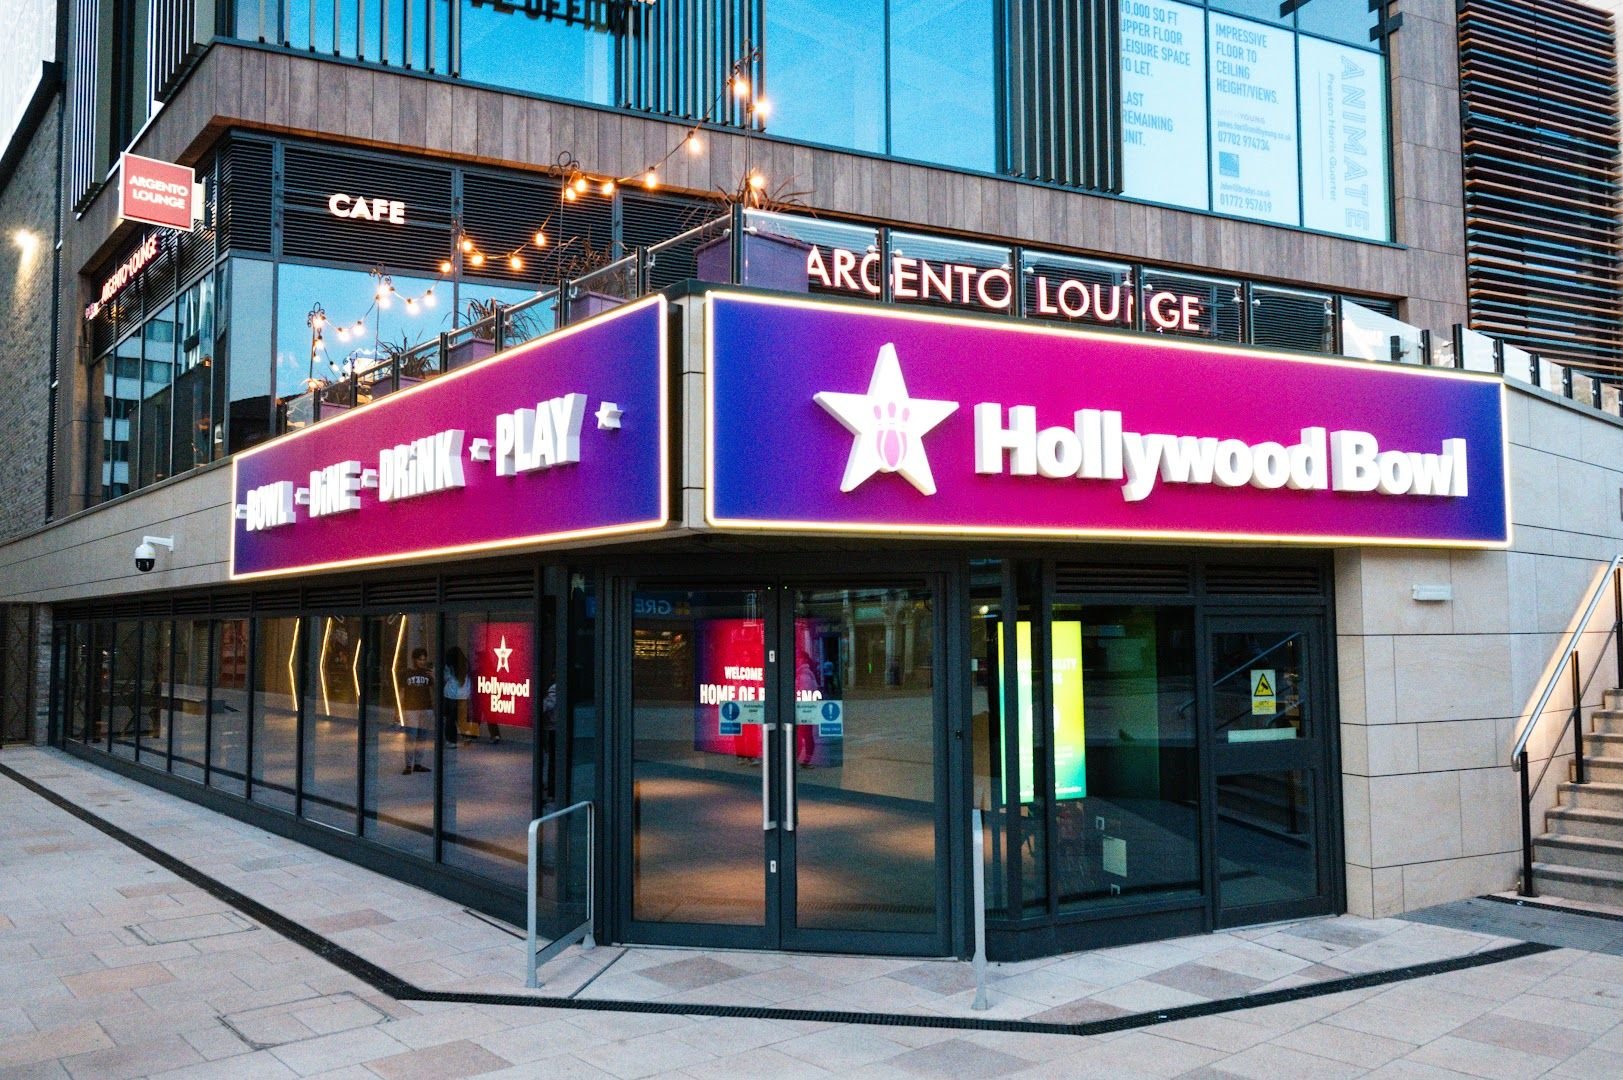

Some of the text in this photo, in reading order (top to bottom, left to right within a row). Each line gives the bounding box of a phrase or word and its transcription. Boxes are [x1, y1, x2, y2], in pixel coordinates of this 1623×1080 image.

[1153, 7, 1165, 22] SQ
[1167, 11, 1178, 26] FT
[1153, 26, 1183, 46] FLOOR
[1216, 23, 1268, 48] IMPRESSIVE
[1161, 46, 1191, 66] SPACE
[1216, 41, 1257, 63] FLOOR TO
[1216, 59, 1250, 80] CEILING
[1341, 55, 1370, 232] ANIMATE
[129, 175, 189, 197] ARGENTO
[132, 189, 185, 209] LOUNGE
[329, 193, 405, 224] CAFE
[246, 480, 296, 531] BOWL
[496, 393, 588, 477] PLAY
[974, 401, 1468, 502] Hollywood Bowl
[724, 666, 763, 681] WELCOME
[477, 676, 530, 698] Hollywood
[490, 695, 515, 714] Bowl
